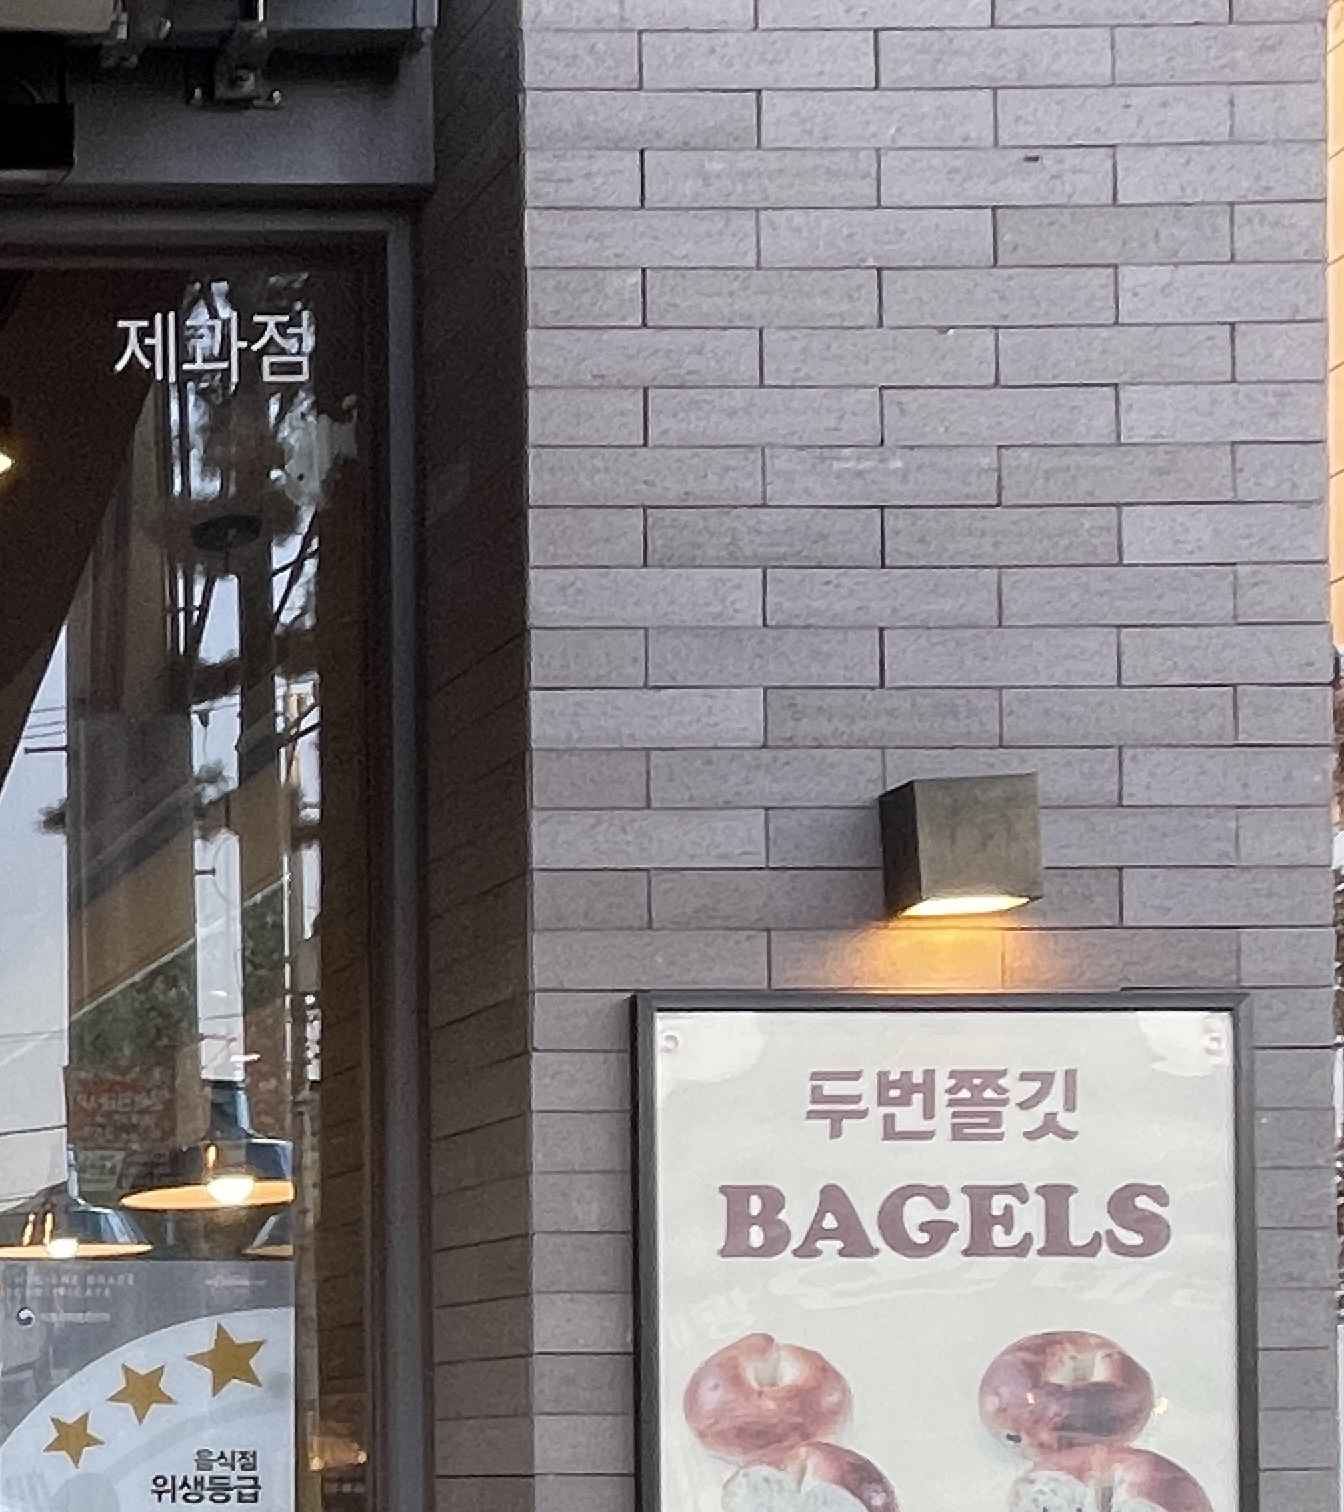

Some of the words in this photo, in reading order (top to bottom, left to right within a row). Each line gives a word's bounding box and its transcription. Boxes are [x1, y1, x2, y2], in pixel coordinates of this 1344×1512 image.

[114, 310, 315, 383] 제과점
[806, 1068, 1080, 1141] 두번쫄깃
[717, 1182, 1172, 1259] BAGELS
[151, 1474, 262, 1504] 위생등급
[194, 1449, 258, 1472] 음식점
